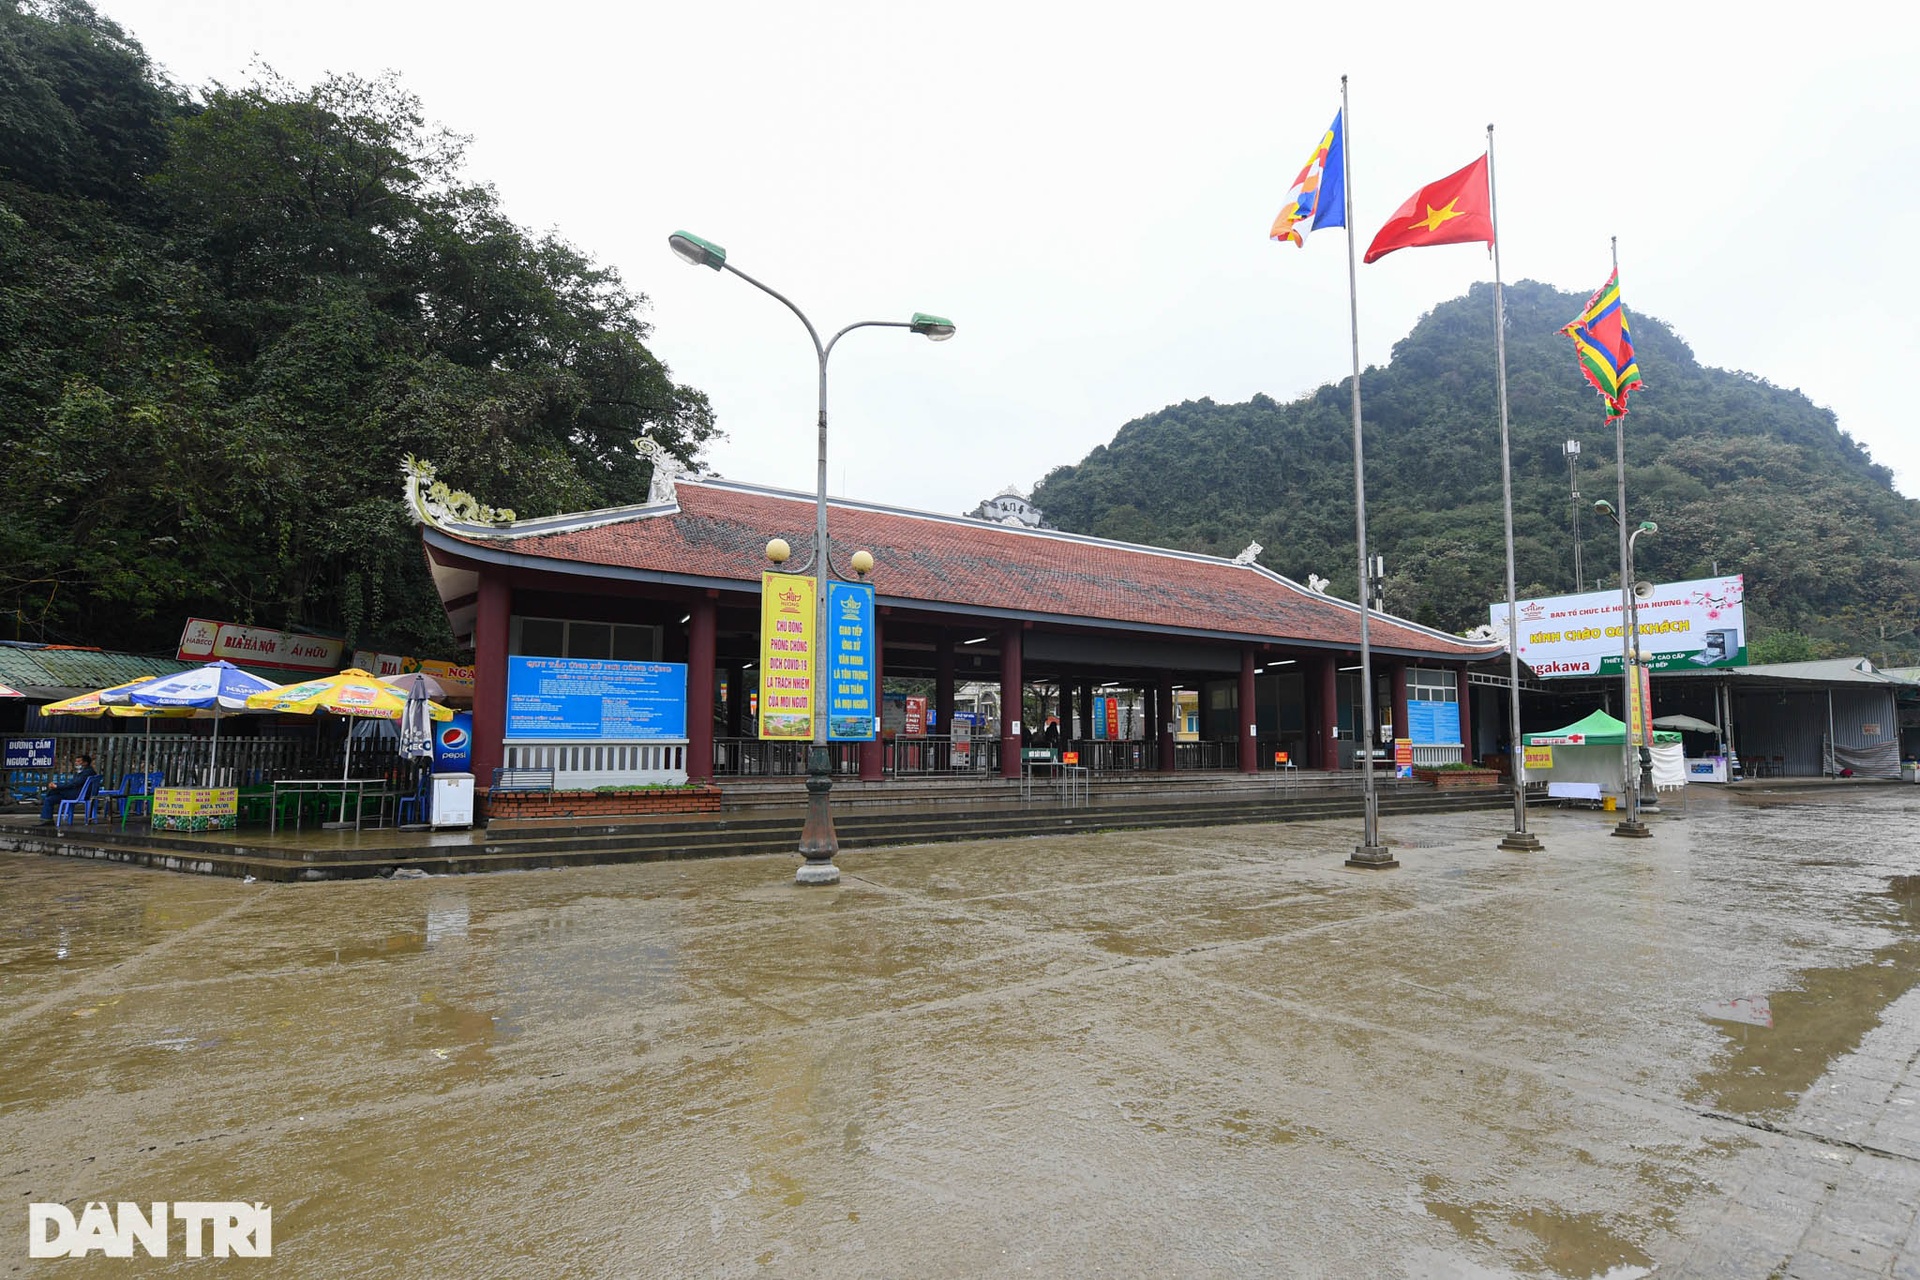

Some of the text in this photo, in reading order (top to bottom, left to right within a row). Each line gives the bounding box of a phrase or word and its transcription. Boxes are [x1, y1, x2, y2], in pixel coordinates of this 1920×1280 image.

[1530, 630, 1561, 644] KÍNH
[1564, 624, 1602, 642] CHÀO
[1639, 619, 1690, 636] KHÁCH
[186, 637, 212, 646] HABECO
[224, 636, 243, 649] BIA
[380, 661, 397, 676] BIA
[784, 658, 807, 671] COVID-19
[9, 738, 51, 749] ĐƯỜNG CẤM
[32, 755, 52, 766] CHIỀU
